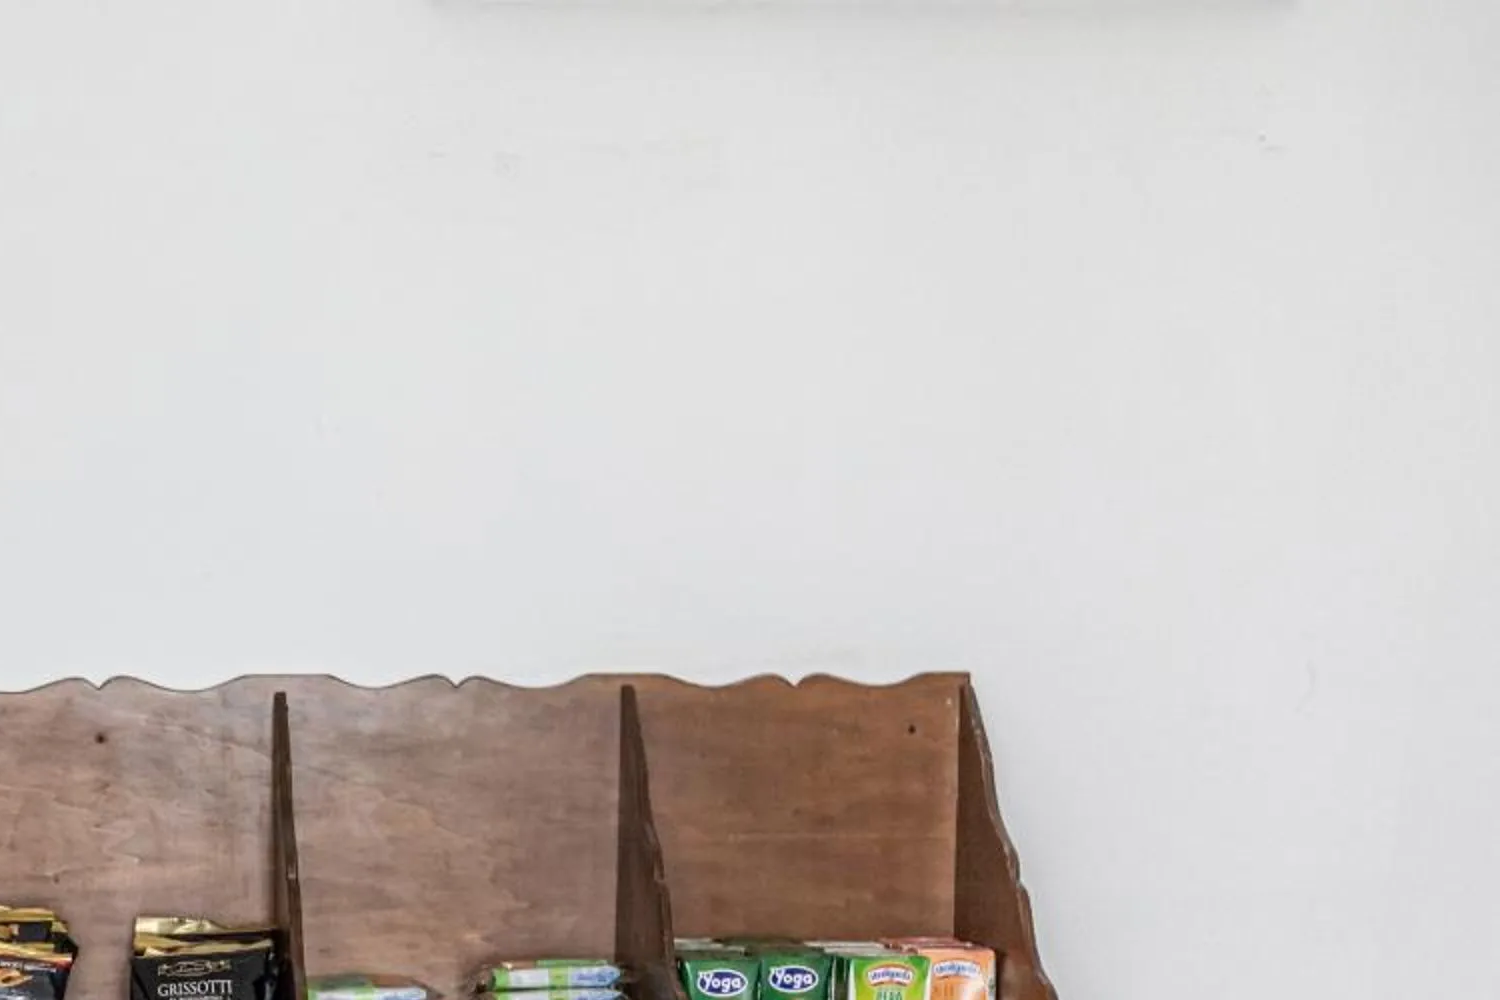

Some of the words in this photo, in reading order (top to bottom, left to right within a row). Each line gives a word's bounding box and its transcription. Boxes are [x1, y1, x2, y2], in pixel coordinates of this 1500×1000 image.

[157, 980, 233, 997] GRISSOTTI
[700, 972, 741, 993] Yoga
[773, 968, 813, 989] Yoga
